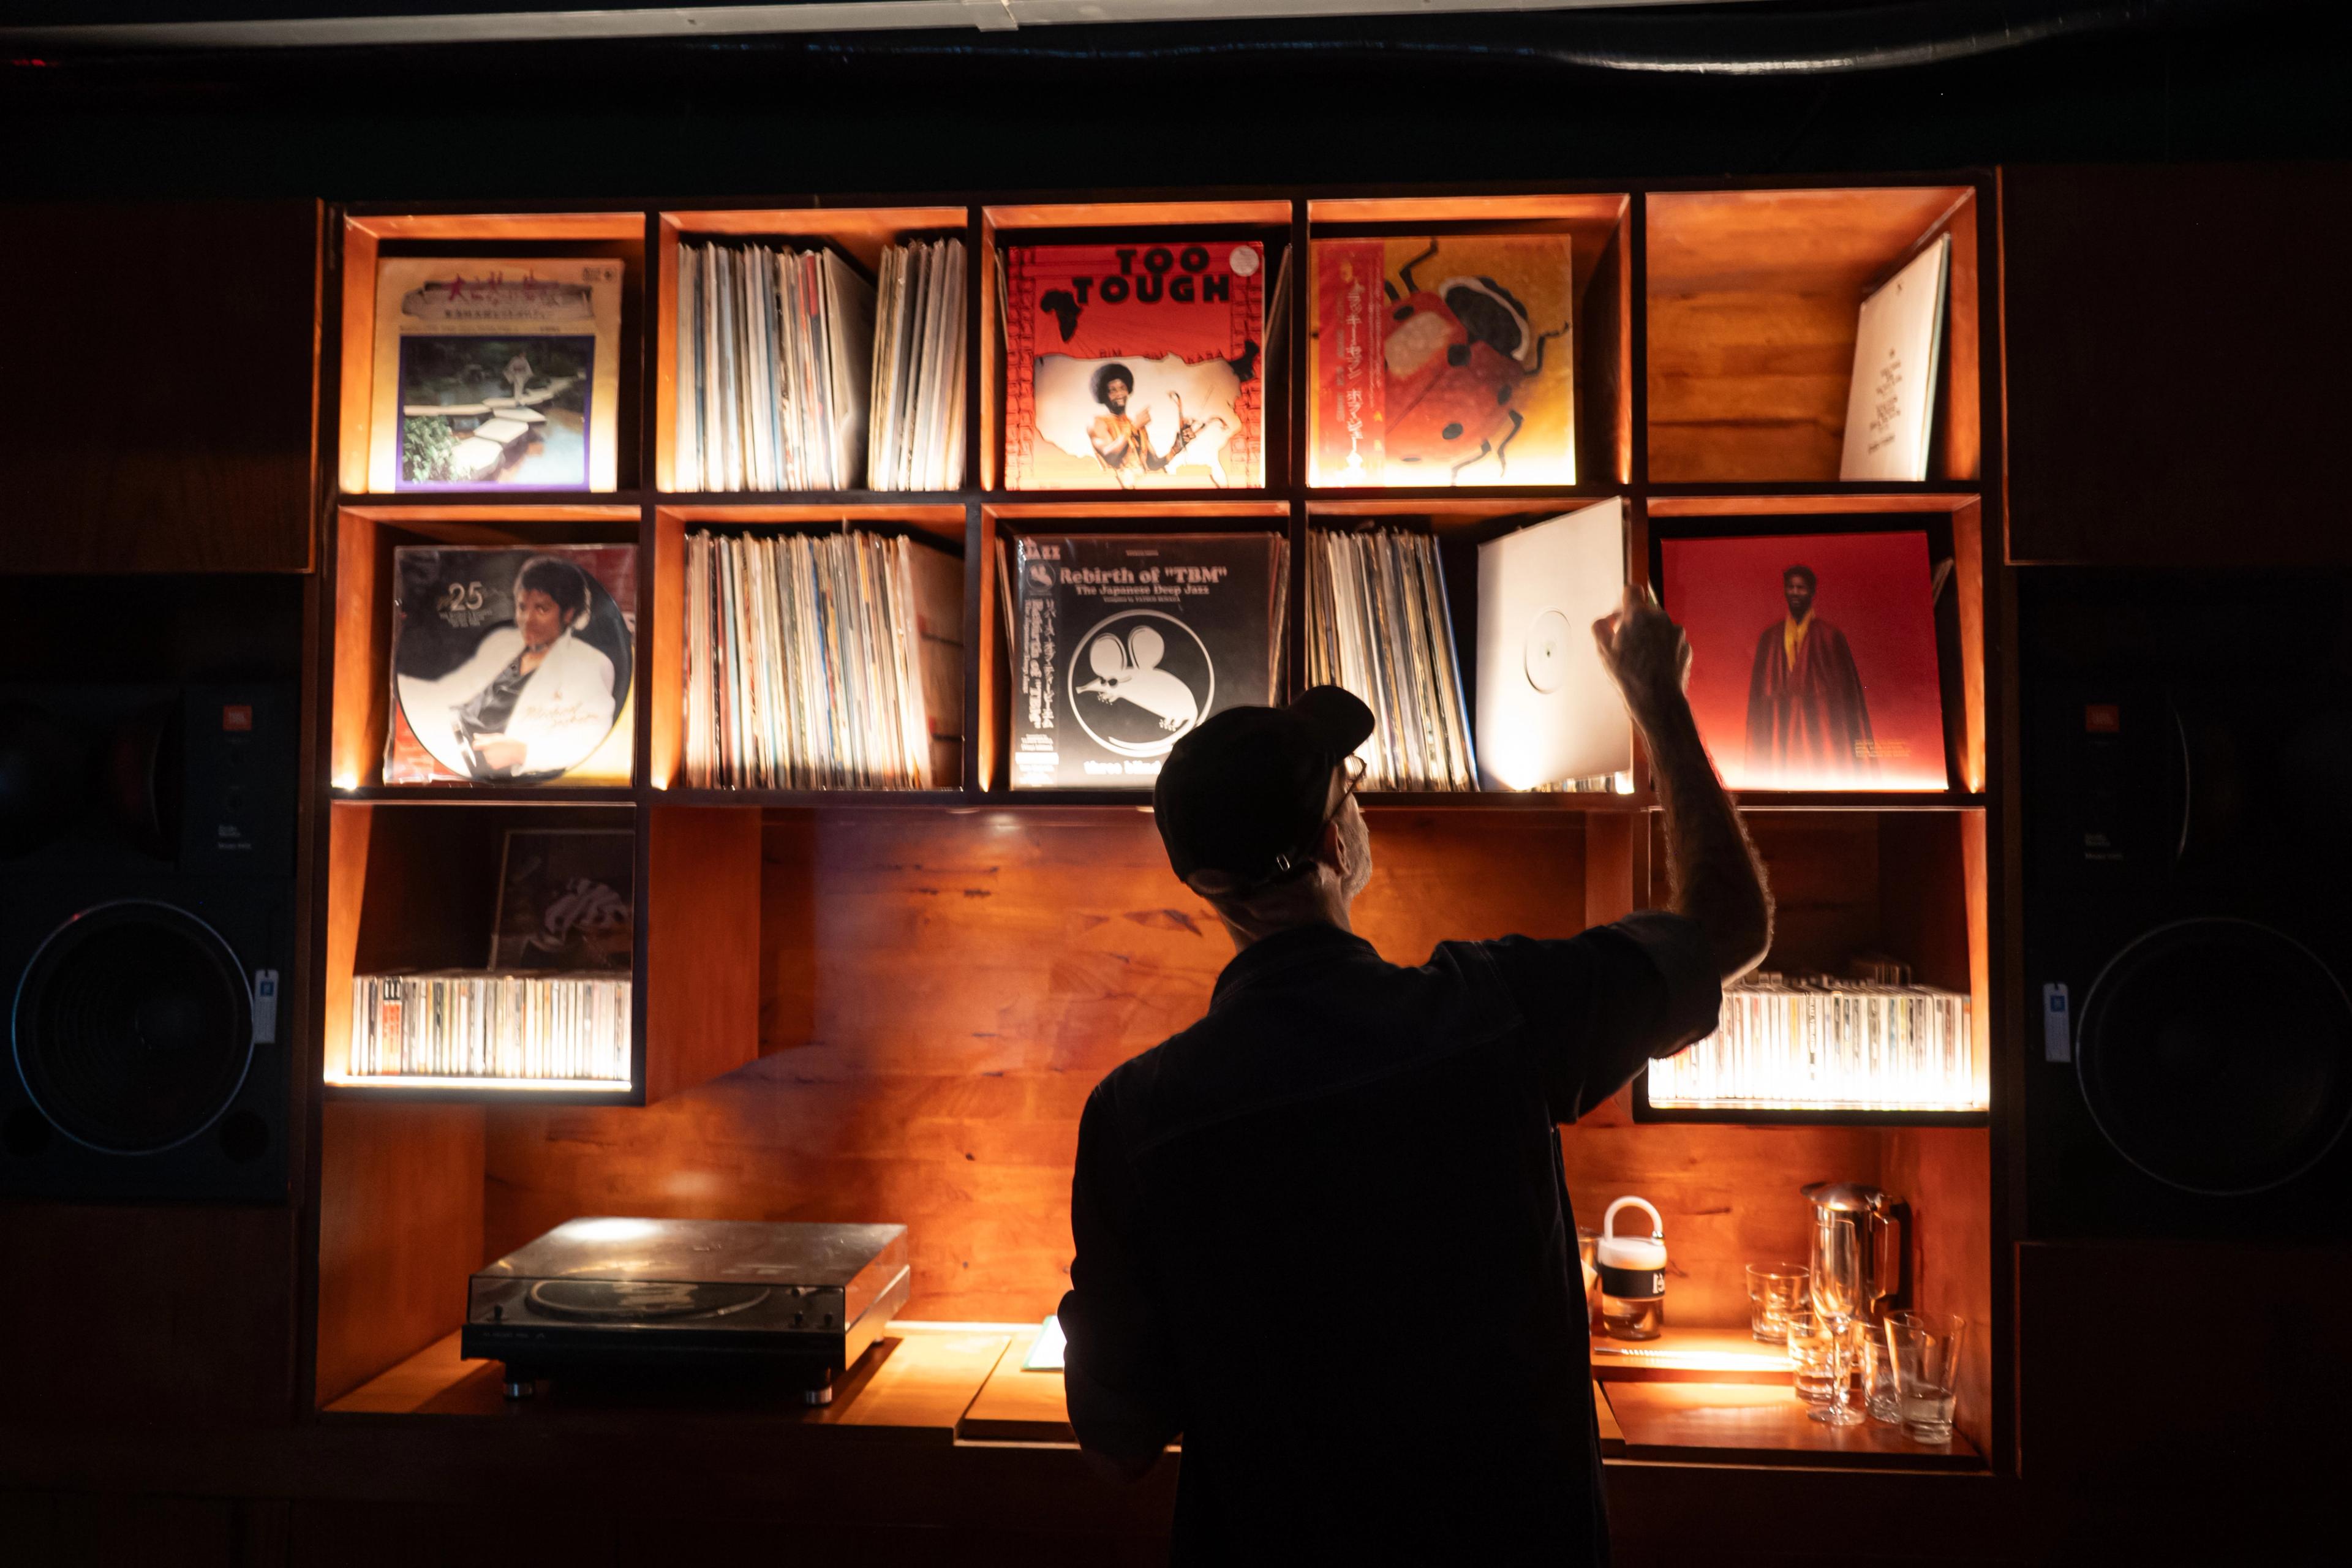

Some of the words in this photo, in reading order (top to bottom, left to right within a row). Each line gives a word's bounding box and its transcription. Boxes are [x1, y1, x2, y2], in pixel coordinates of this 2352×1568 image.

[1115, 246, 1210, 276] TOO
[1072, 275, 1230, 305] TOUGH
[1060, 566, 1134, 584] Rebirth
[1139, 566, 1160, 584] of
[449, 581, 483, 611] 25
[1076, 585, 1096, 595] The
[1099, 585, 1151, 597] Japanese
[1184, 584, 1210, 595] Jazz
